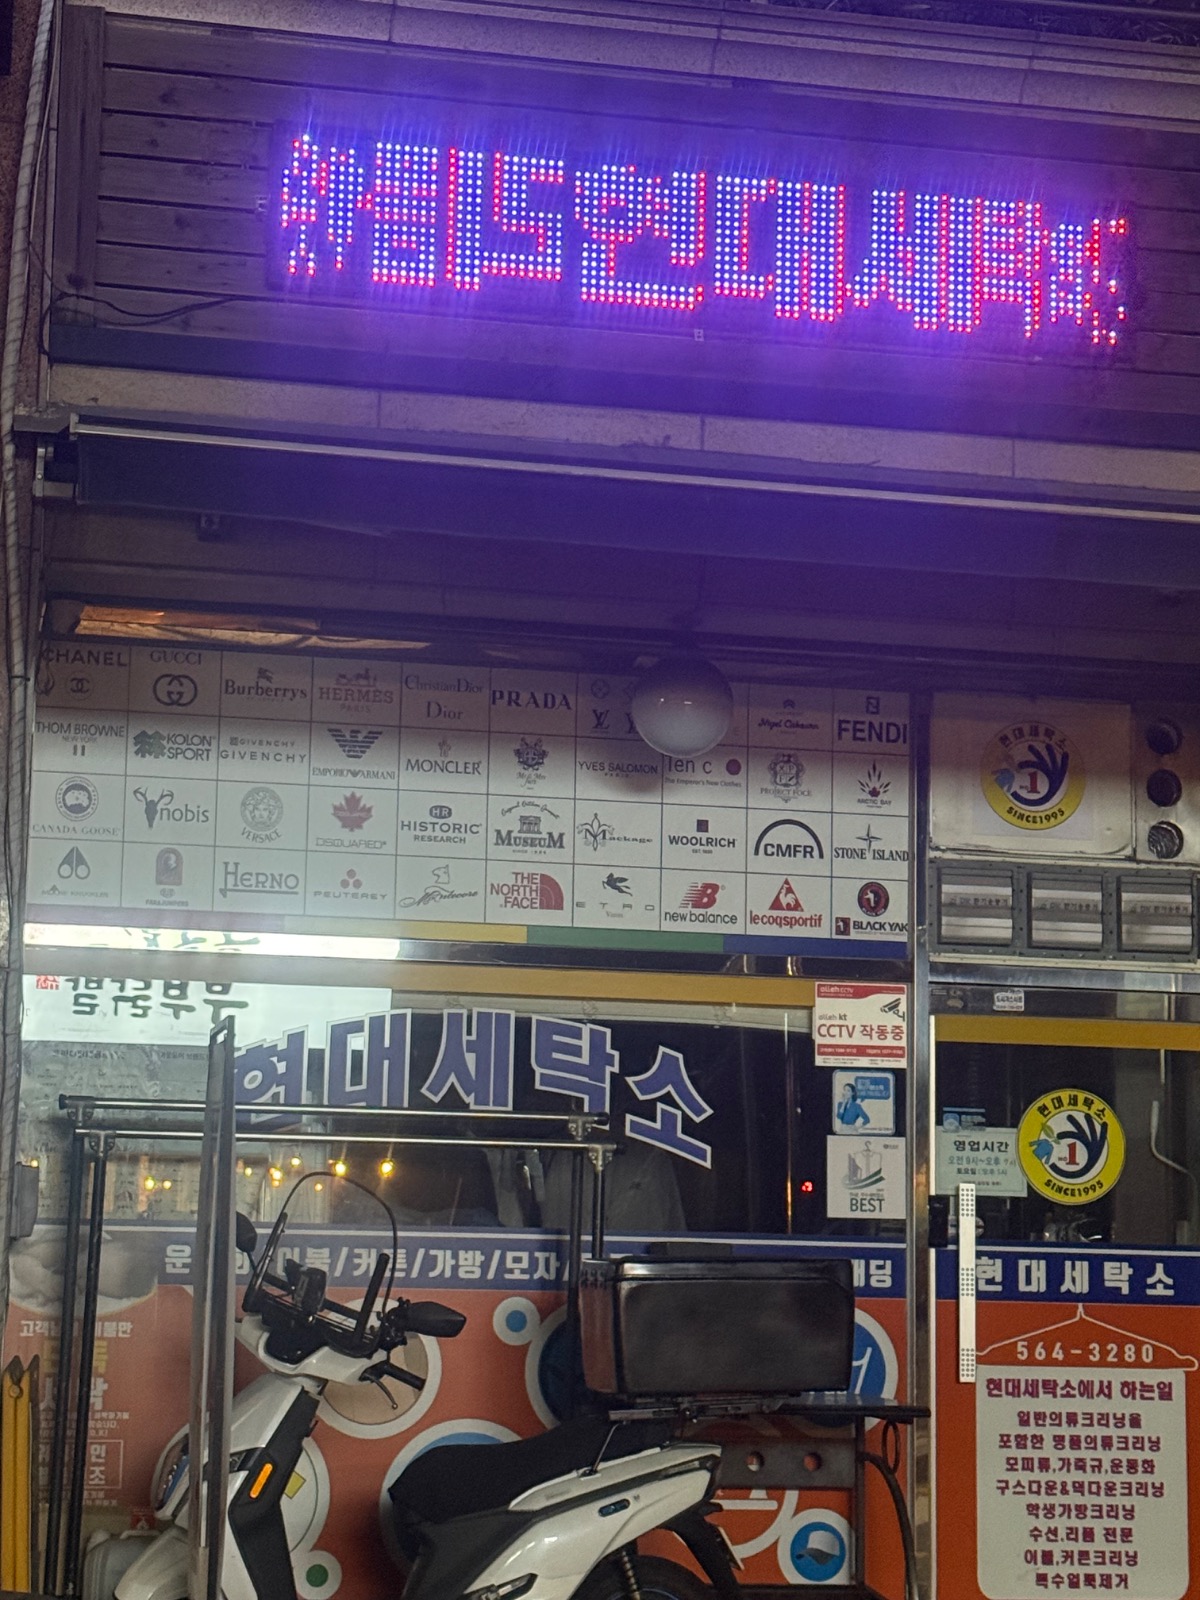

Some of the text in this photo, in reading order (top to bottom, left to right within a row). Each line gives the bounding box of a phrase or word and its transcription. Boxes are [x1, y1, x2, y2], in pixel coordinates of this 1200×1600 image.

[44, 648, 128, 666] CHANEL
[150, 649, 202, 665] GUCCI
[225, 679, 307, 701] Burberrys
[491, 689, 572, 710] PRADA
[426, 701, 463, 720] Dior
[36, 721, 125, 738] THOM BROWNE
[836, 719, 909, 745] FENDI
[166, 733, 212, 747] KOLON
[166, 747, 212, 761] SPORT
[220, 750, 307, 764] GIVENCHY
[361, 770, 395, 781] ARMANI
[405, 759, 482, 776] MONCLER
[578, 761, 658, 774] YVES SALOMON
[159, 804, 210, 823] nobis
[32, 824, 119, 836] CANADA GOOSE
[241, 828, 282, 843] VERSACE
[401, 820, 480, 835] HISTORIC
[413, 835, 466, 844] RESEARCH
[668, 835, 736, 848] WOOLRICH
[763, 843, 815, 859] CMFR
[834, 847, 909, 862] STONE ISLAND
[512, 872, 539, 885] THE
[313, 890, 388, 900] PEUTEREY
[490, 883, 539, 896] NORTH
[503, 896, 539, 909] FACE
[817, 1024, 905, 1041] CCTV 작동중
[1037, 1093, 1108, 1121] 현대세탁소
[953, 1140, 1010, 1153] 영업시간
[849, 1197, 885, 1213] BEST
[975, 1257, 1176, 1296] 현대세탁소
[1017, 1342, 1154, 1362] 564-3280
[986, 1377, 1174, 1401] 현대세탁소에서 하는일
[1017, 1410, 1142, 1429] 일반의류크리닝을
[998, 1433, 1161, 1452] 포함한 명품의류크리닝
[1026, 1503, 1136, 1521] 학생가방크리닝
[1103, 1526, 1134, 1544] 전문
[1035, 1572, 1129, 1590] 특수얼룩제거
